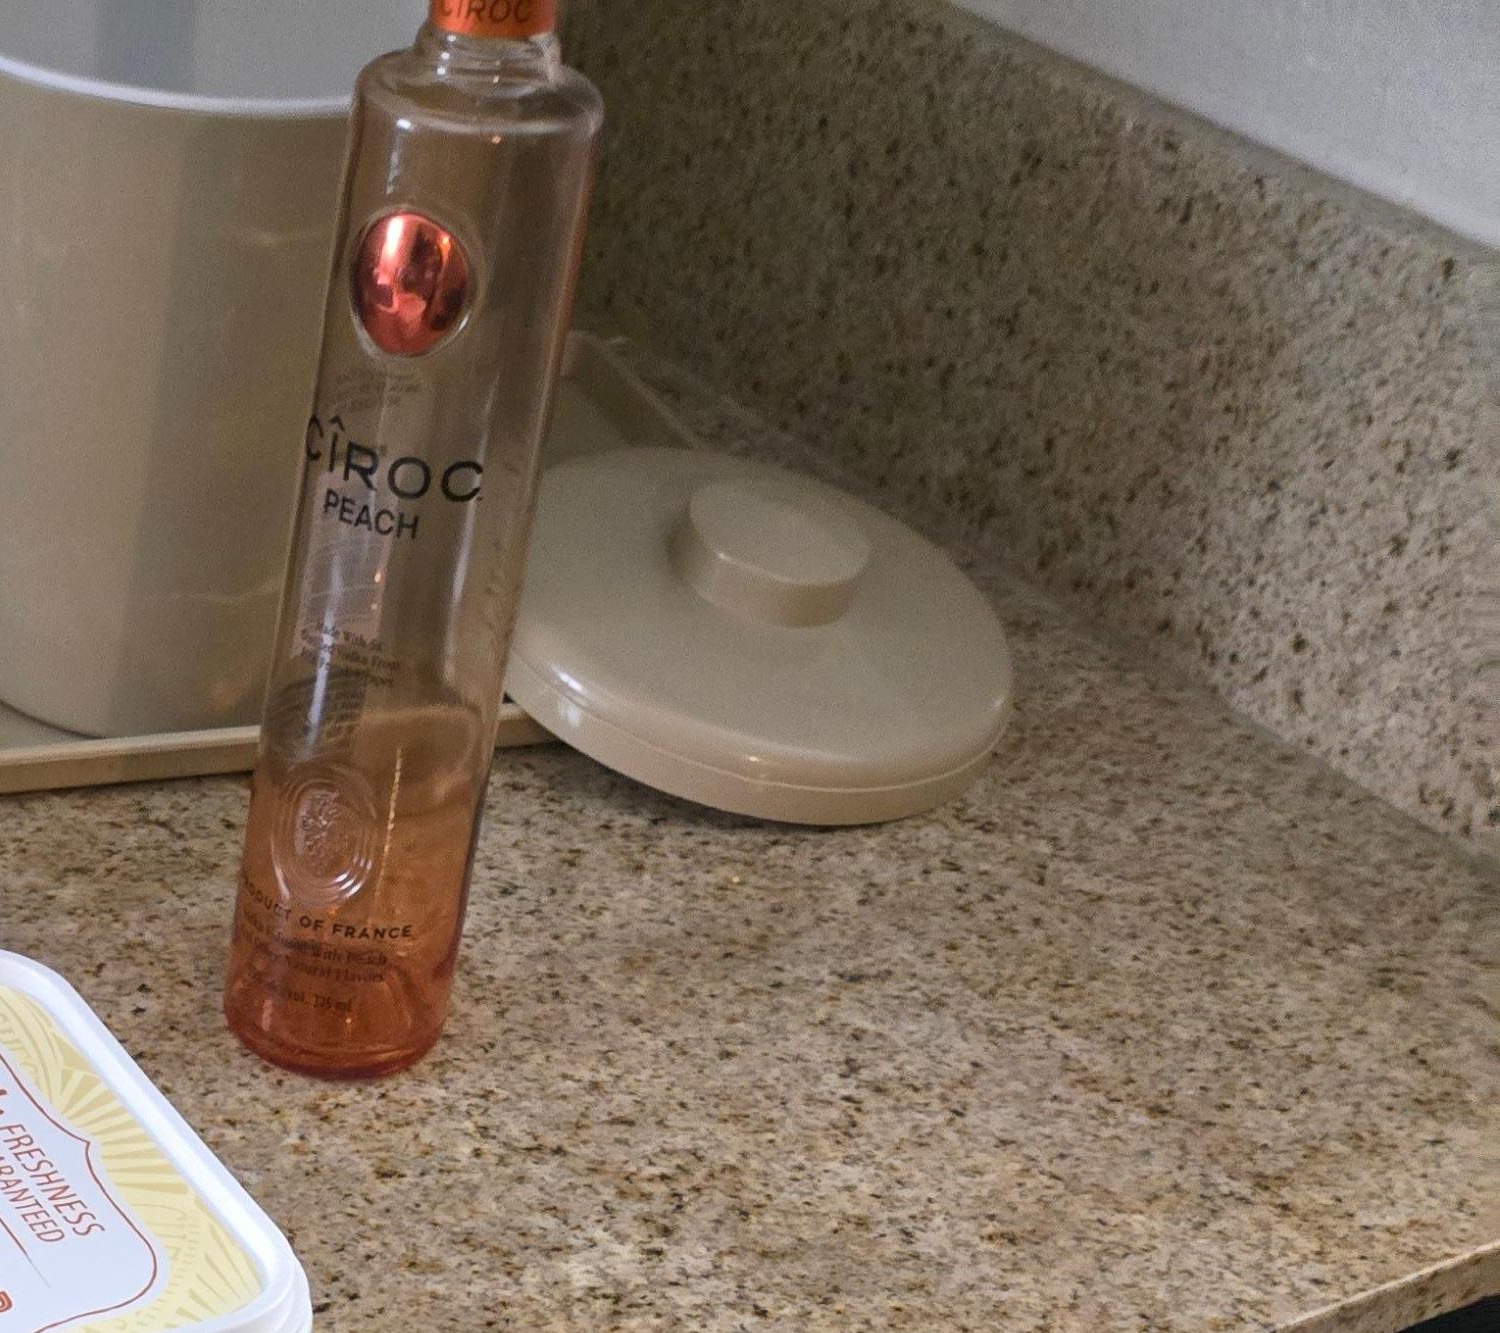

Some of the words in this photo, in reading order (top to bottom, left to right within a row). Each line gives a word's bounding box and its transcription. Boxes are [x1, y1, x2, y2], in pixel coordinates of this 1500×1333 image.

[323, 487, 419, 540] PEACH
[299, 914, 326, 932] OF
[331, 924, 414, 940] FRANCE
